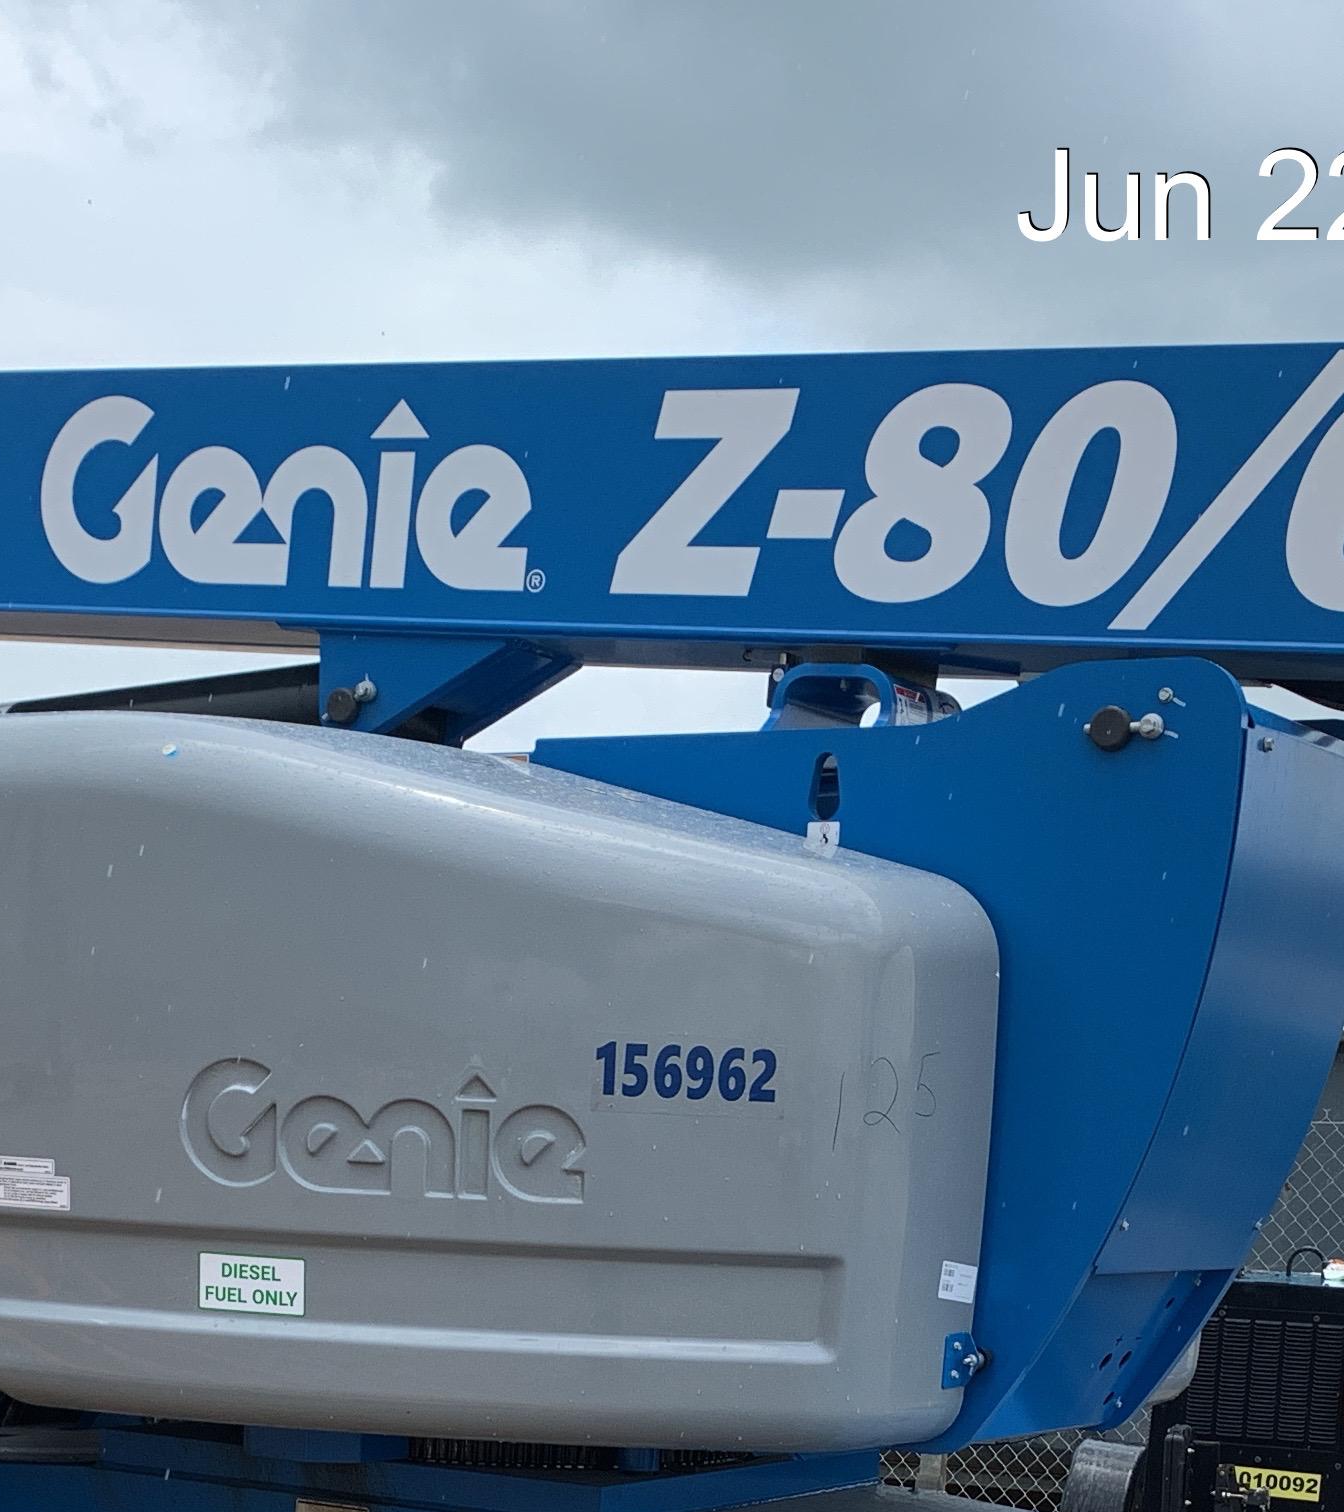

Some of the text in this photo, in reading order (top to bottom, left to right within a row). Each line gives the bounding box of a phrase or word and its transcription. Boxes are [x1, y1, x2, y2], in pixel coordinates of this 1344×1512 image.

[596, 1041, 777, 1103] 156962
[179, 1056, 588, 1204] Genie
[221, 1262, 281, 1281] DIESEL
[205, 1285, 298, 1307] FUEL ONLY
[1239, 1471, 1319, 1495] 010092
